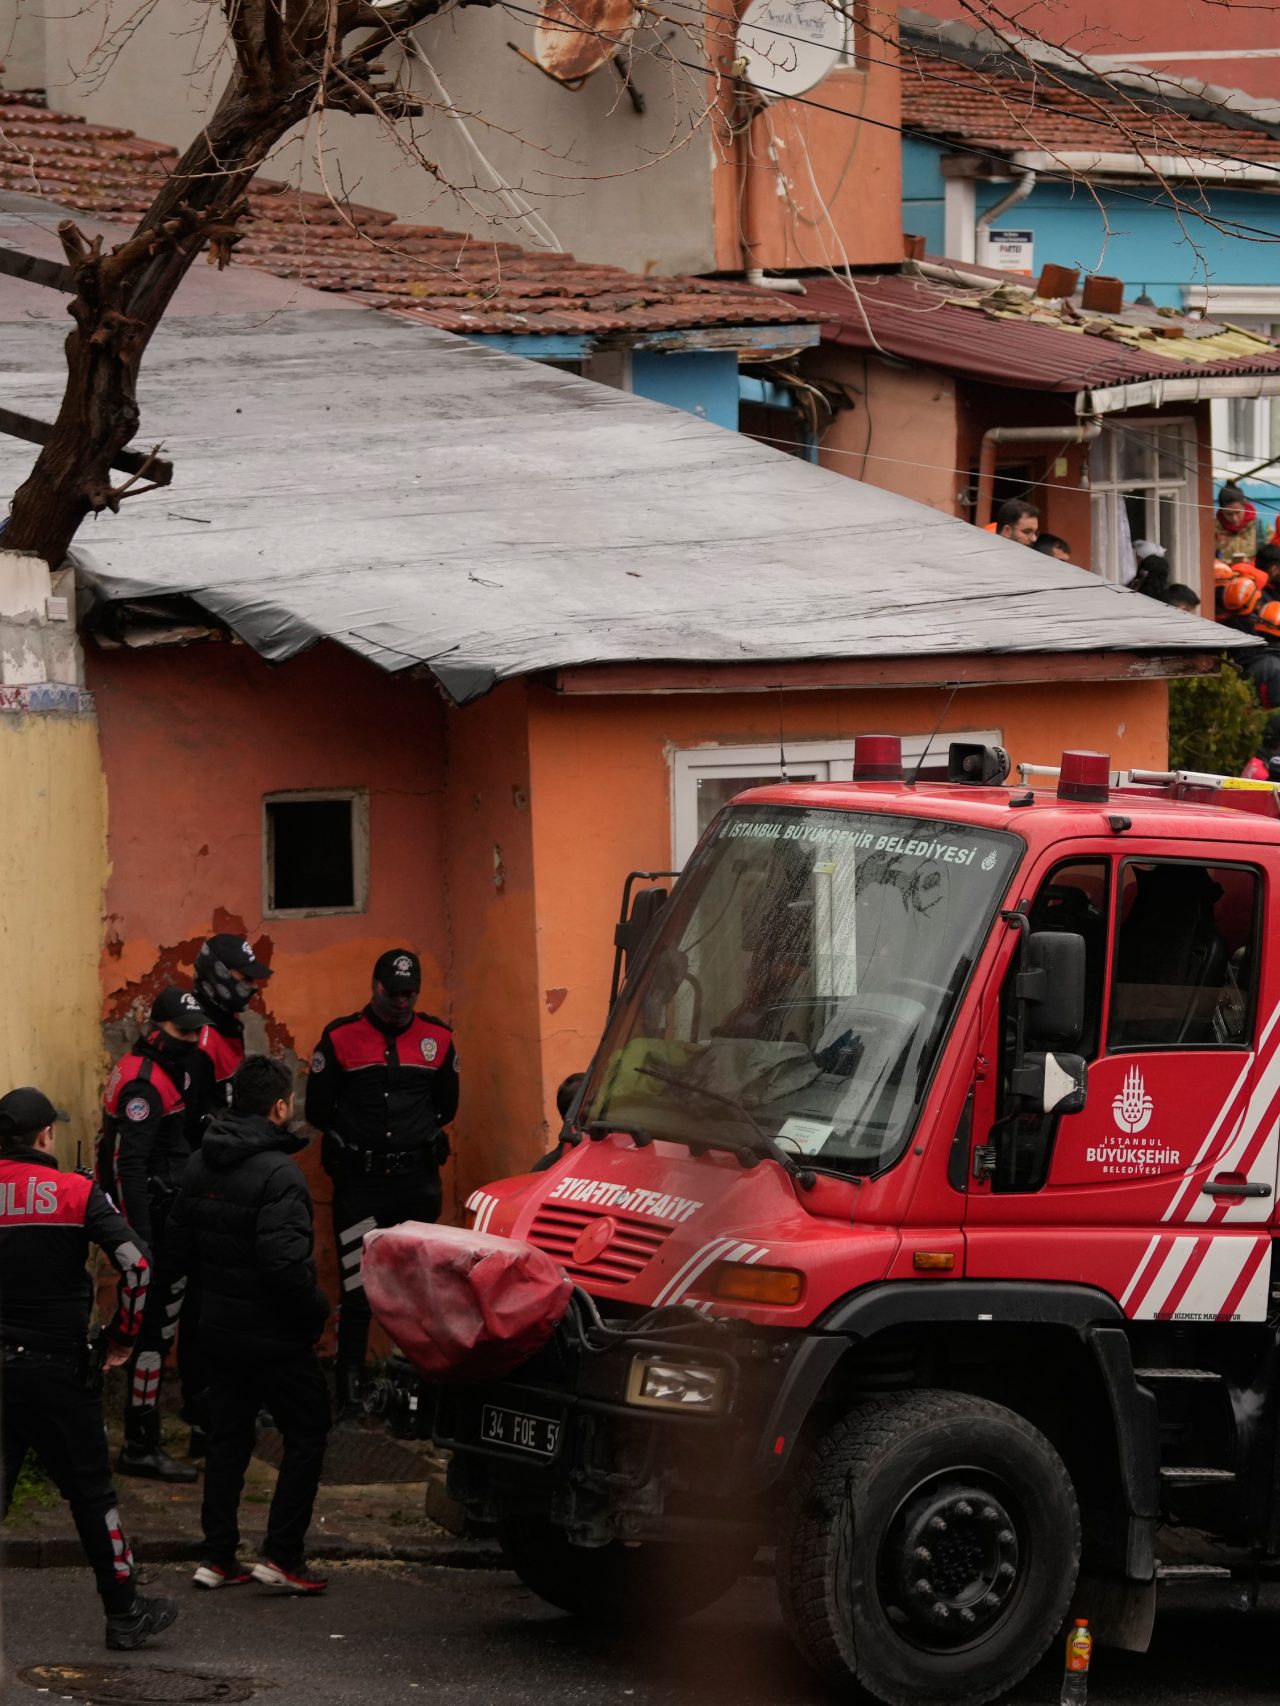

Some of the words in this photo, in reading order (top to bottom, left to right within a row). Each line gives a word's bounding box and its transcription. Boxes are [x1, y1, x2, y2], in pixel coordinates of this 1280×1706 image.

[728, 820, 781, 839] İSTANBUL
[875, 835, 976, 866] BELEDİYESİ
[1104, 1136, 1162, 1146] İSTANBUL
[1086, 1144, 1180, 1167] BÜYÜKŞEHİR
[1103, 1165, 1161, 1174] BELEDİYESİ
[489, 1410, 503, 1439] 34
[513, 1416, 536, 1447] FOE
